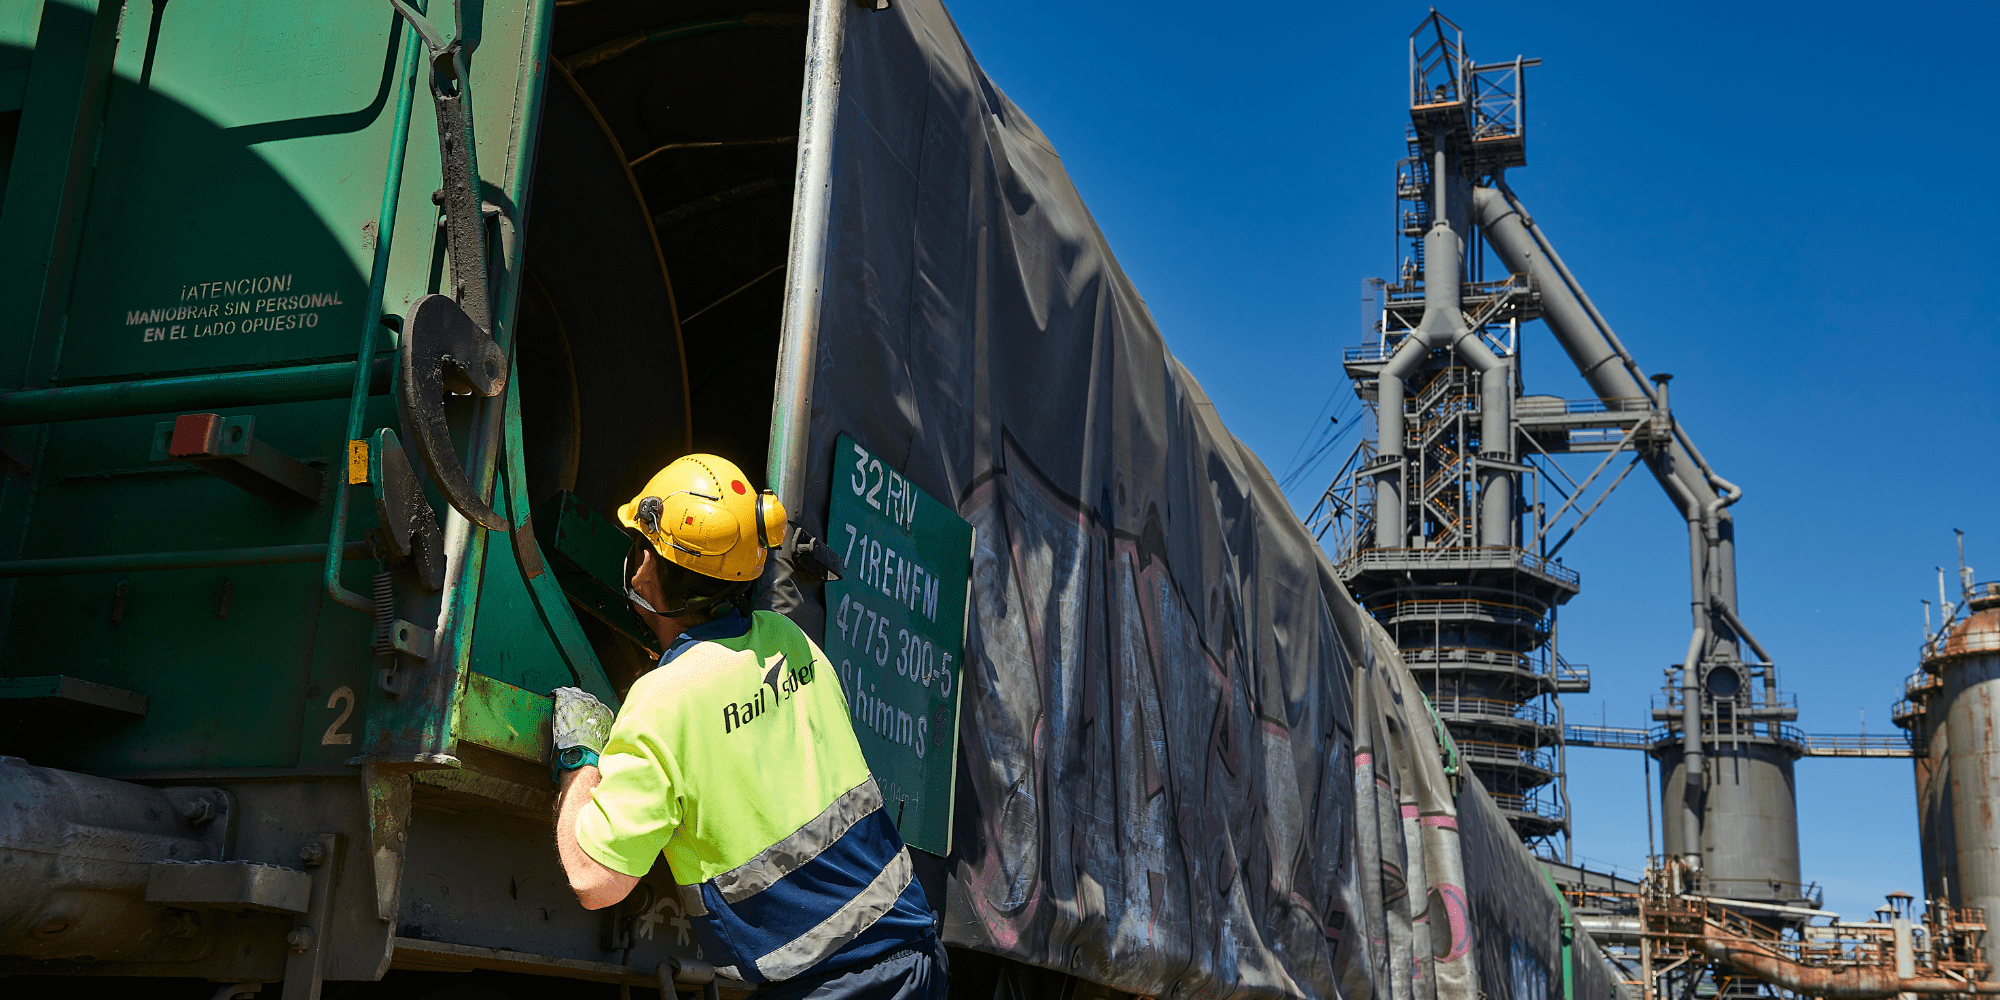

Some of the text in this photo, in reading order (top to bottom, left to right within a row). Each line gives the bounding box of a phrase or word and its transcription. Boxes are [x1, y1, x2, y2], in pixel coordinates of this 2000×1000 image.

[126, 290, 343, 325] MANIOBRAR SIN PERSONAL
[181, 274, 292, 301] ¡ATENCION!
[143, 313, 318, 342] EN EL LADO OPUESTO
[836, 593, 953, 698] 4775 300-5
[322, 686, 355, 746] 2
[723, 687, 765, 734] Rail
[842, 658, 928, 759] Shimms
